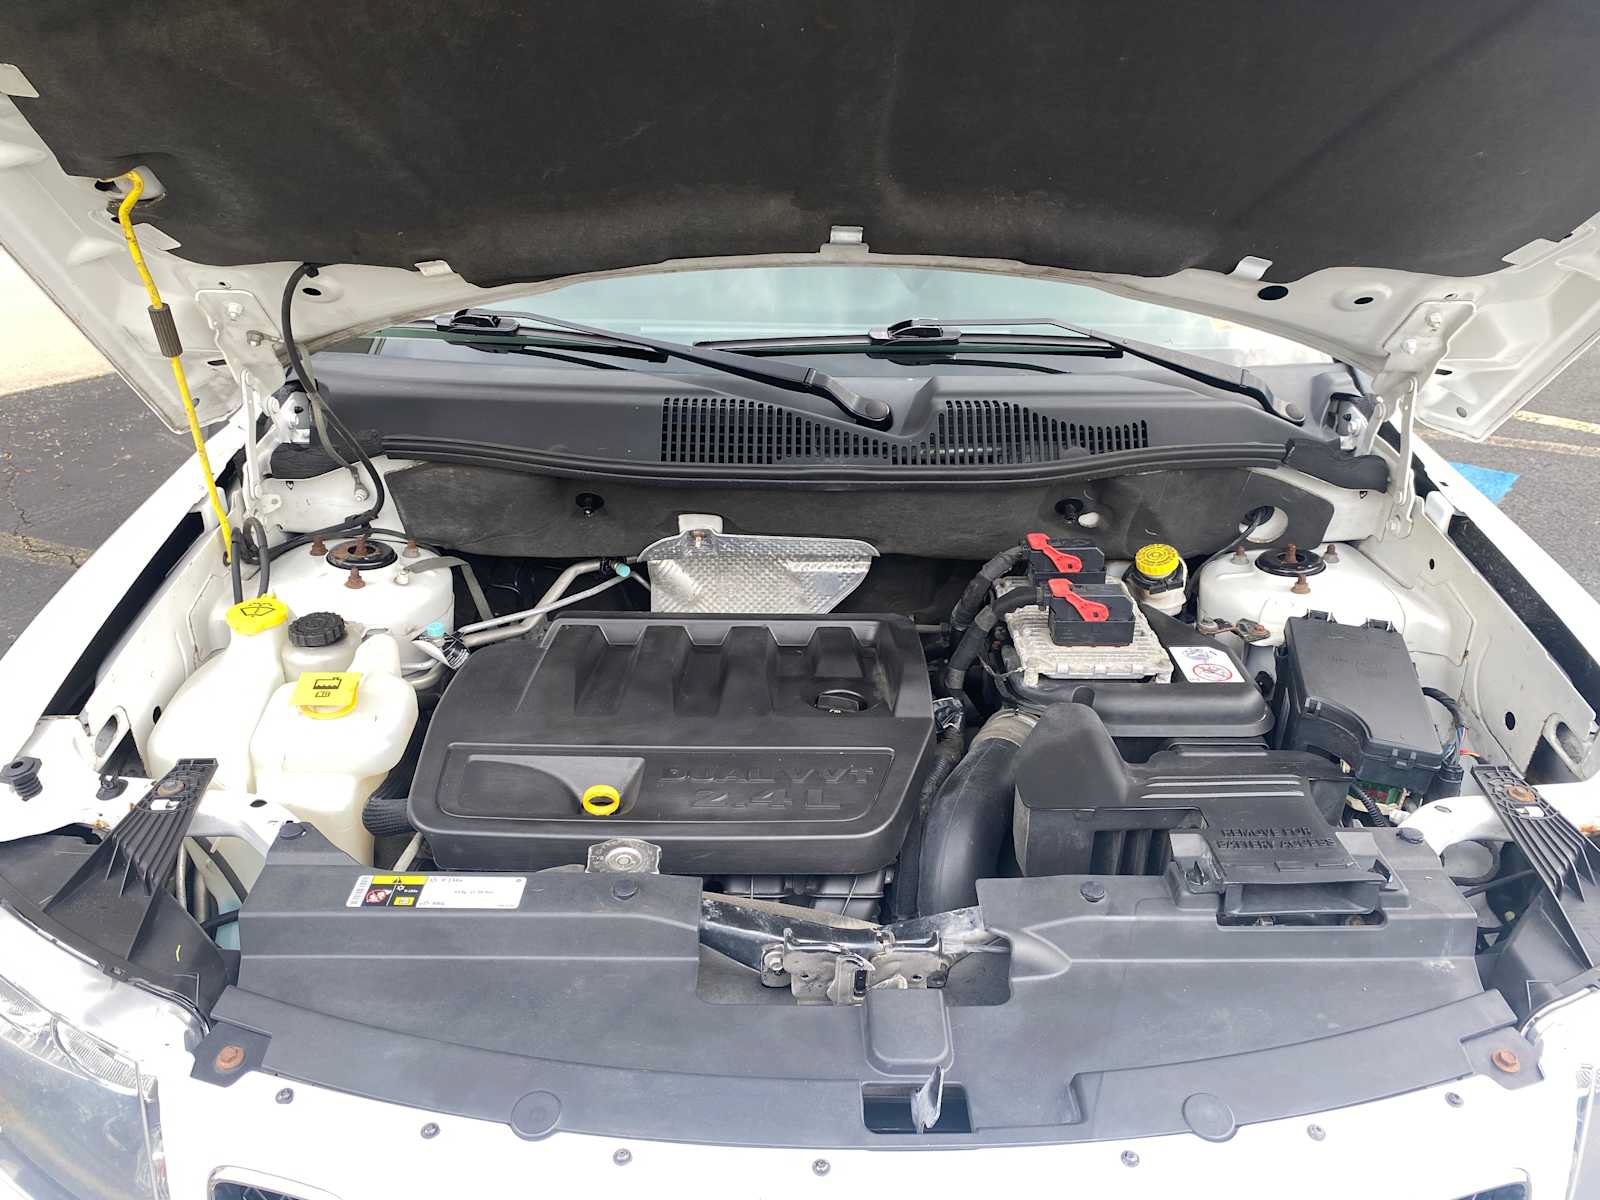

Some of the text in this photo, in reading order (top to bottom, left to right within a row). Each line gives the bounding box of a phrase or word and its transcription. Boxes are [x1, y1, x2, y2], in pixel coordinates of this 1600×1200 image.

[657, 767, 776, 784] DUAL
[1221, 827, 1312, 838] REMOVE FOR
[1216, 839, 1336, 849] BATTERY ACCESS
